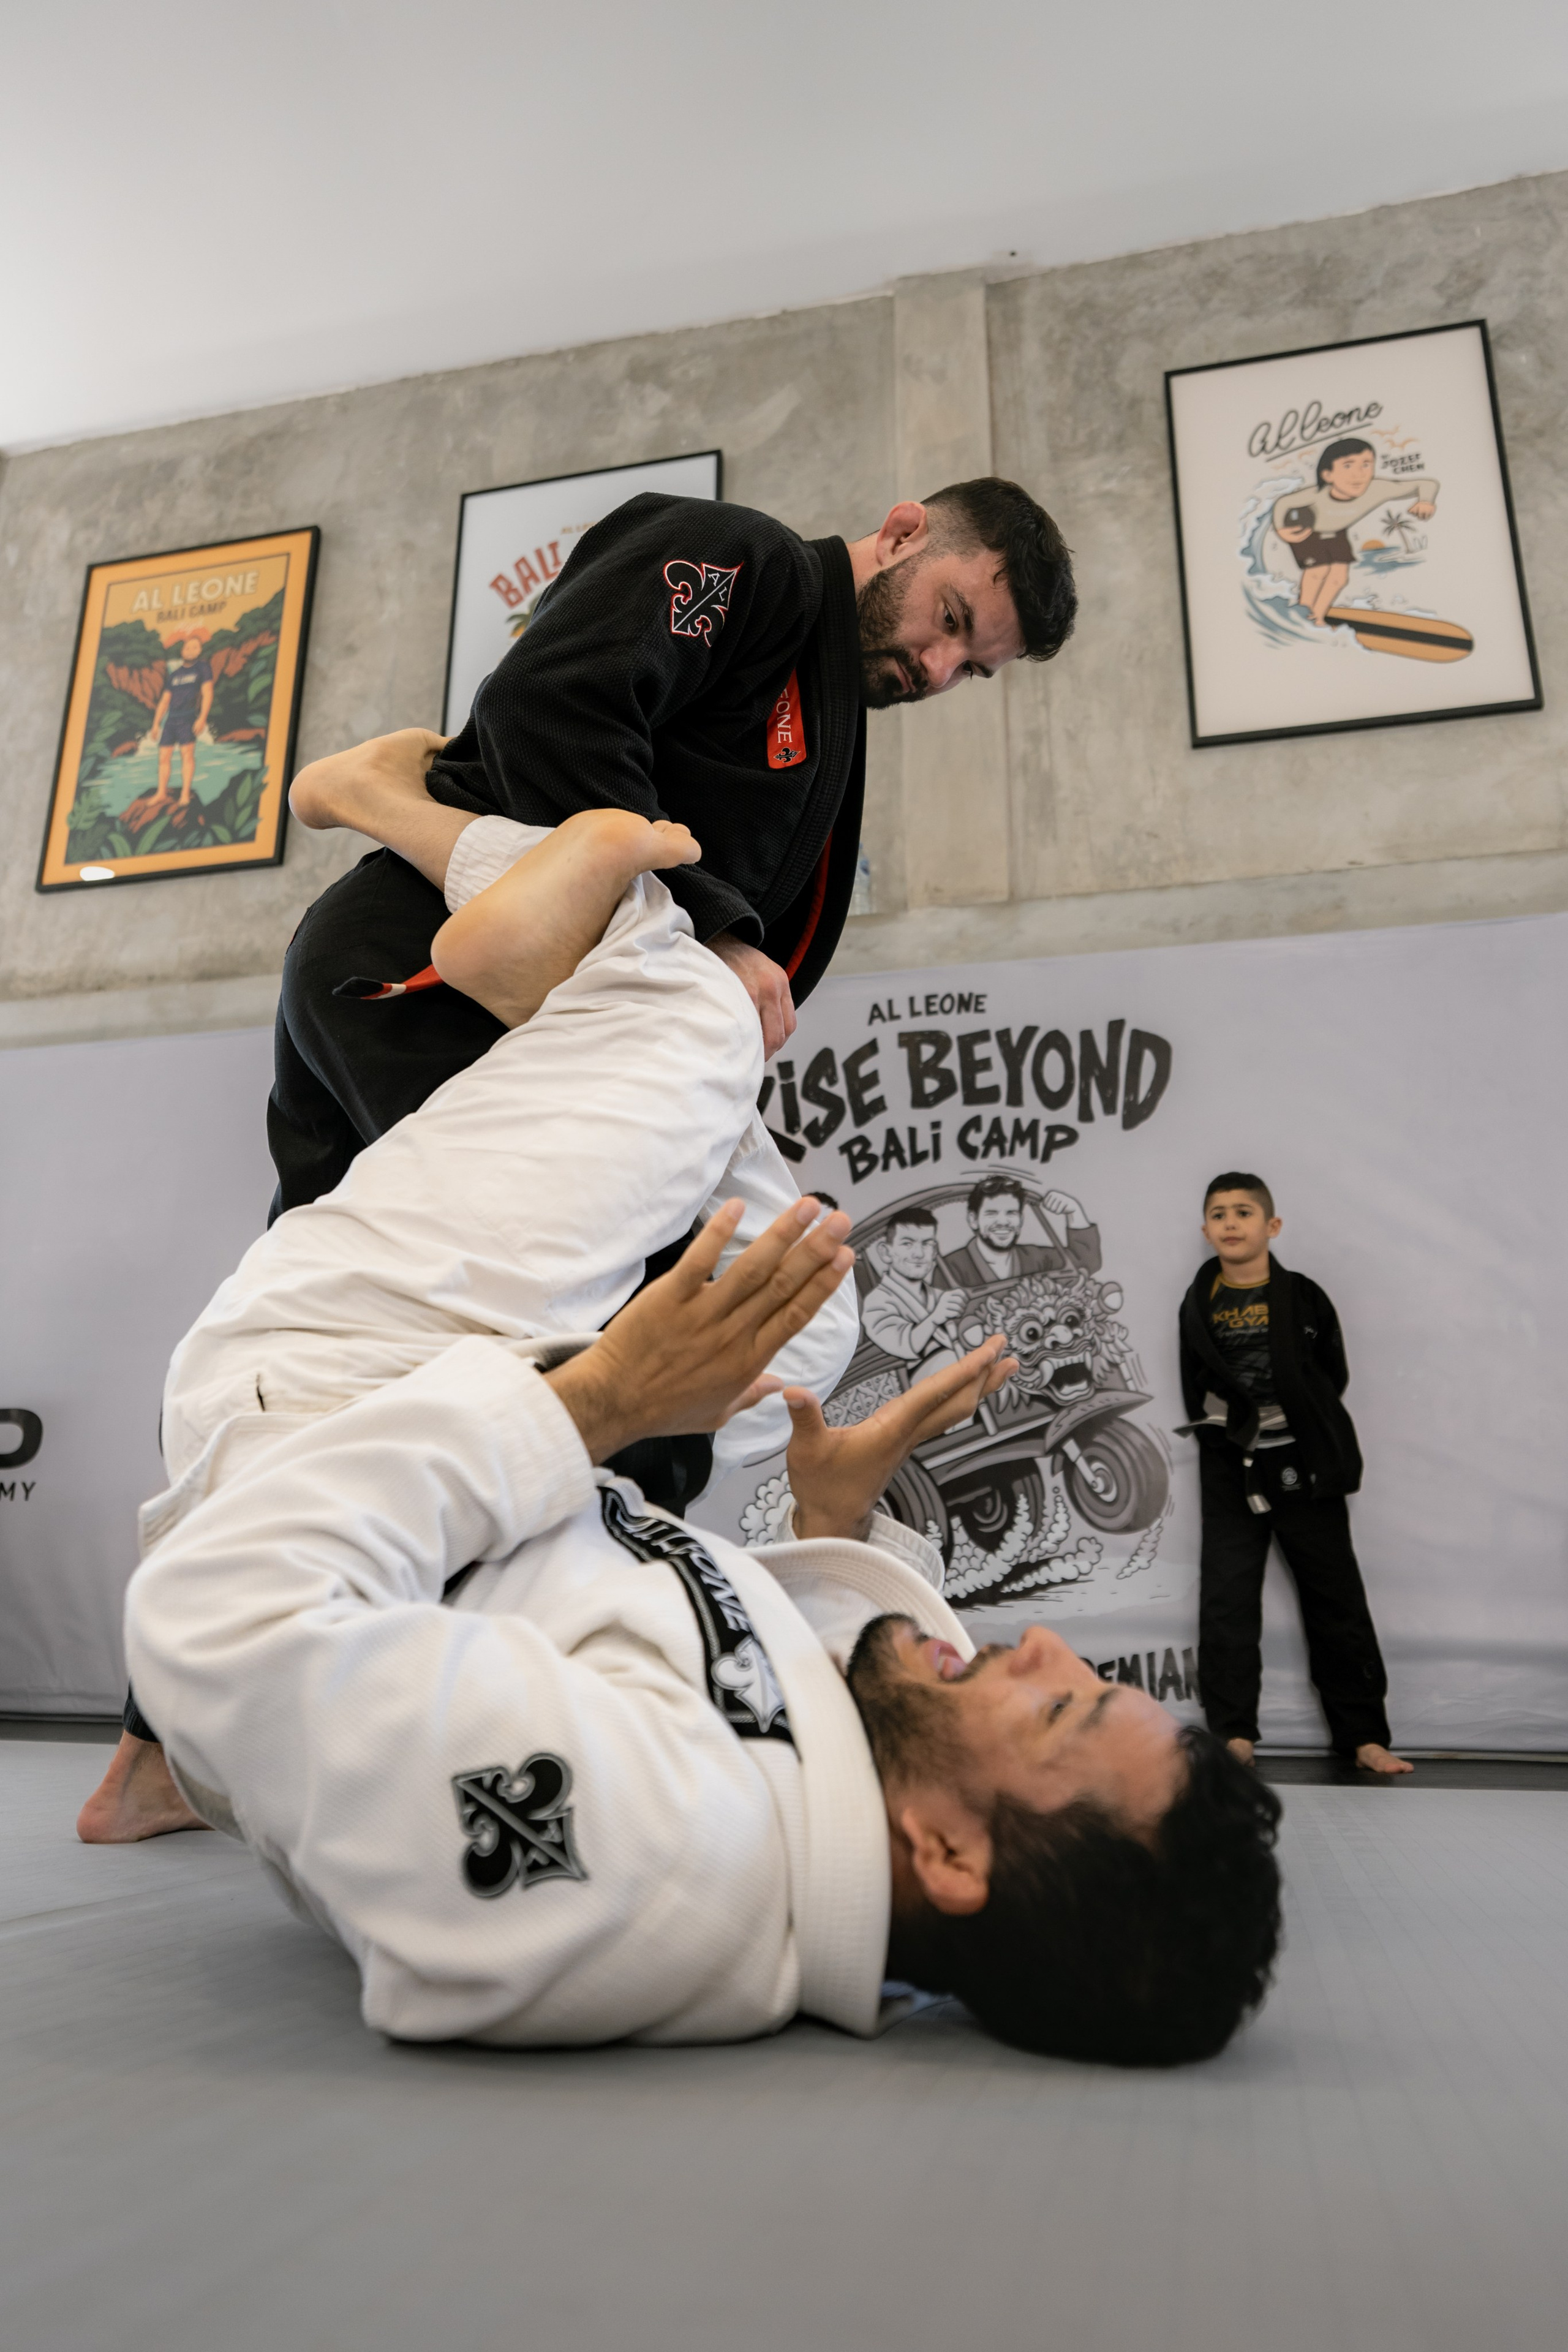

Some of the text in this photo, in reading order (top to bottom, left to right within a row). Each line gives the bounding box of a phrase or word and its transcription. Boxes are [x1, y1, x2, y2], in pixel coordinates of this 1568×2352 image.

[131, 571, 258, 612] AL LEONE
[489, 541, 562, 608] BALI
[157, 601, 227, 624] BALI CAMP
[868, 992, 987, 1025] AL LEONE
[898, 1019, 1172, 1131] BEYOND
[957, 1115, 1079, 1164] CAMP
[1079, 1646, 1205, 1708] EMIAN
